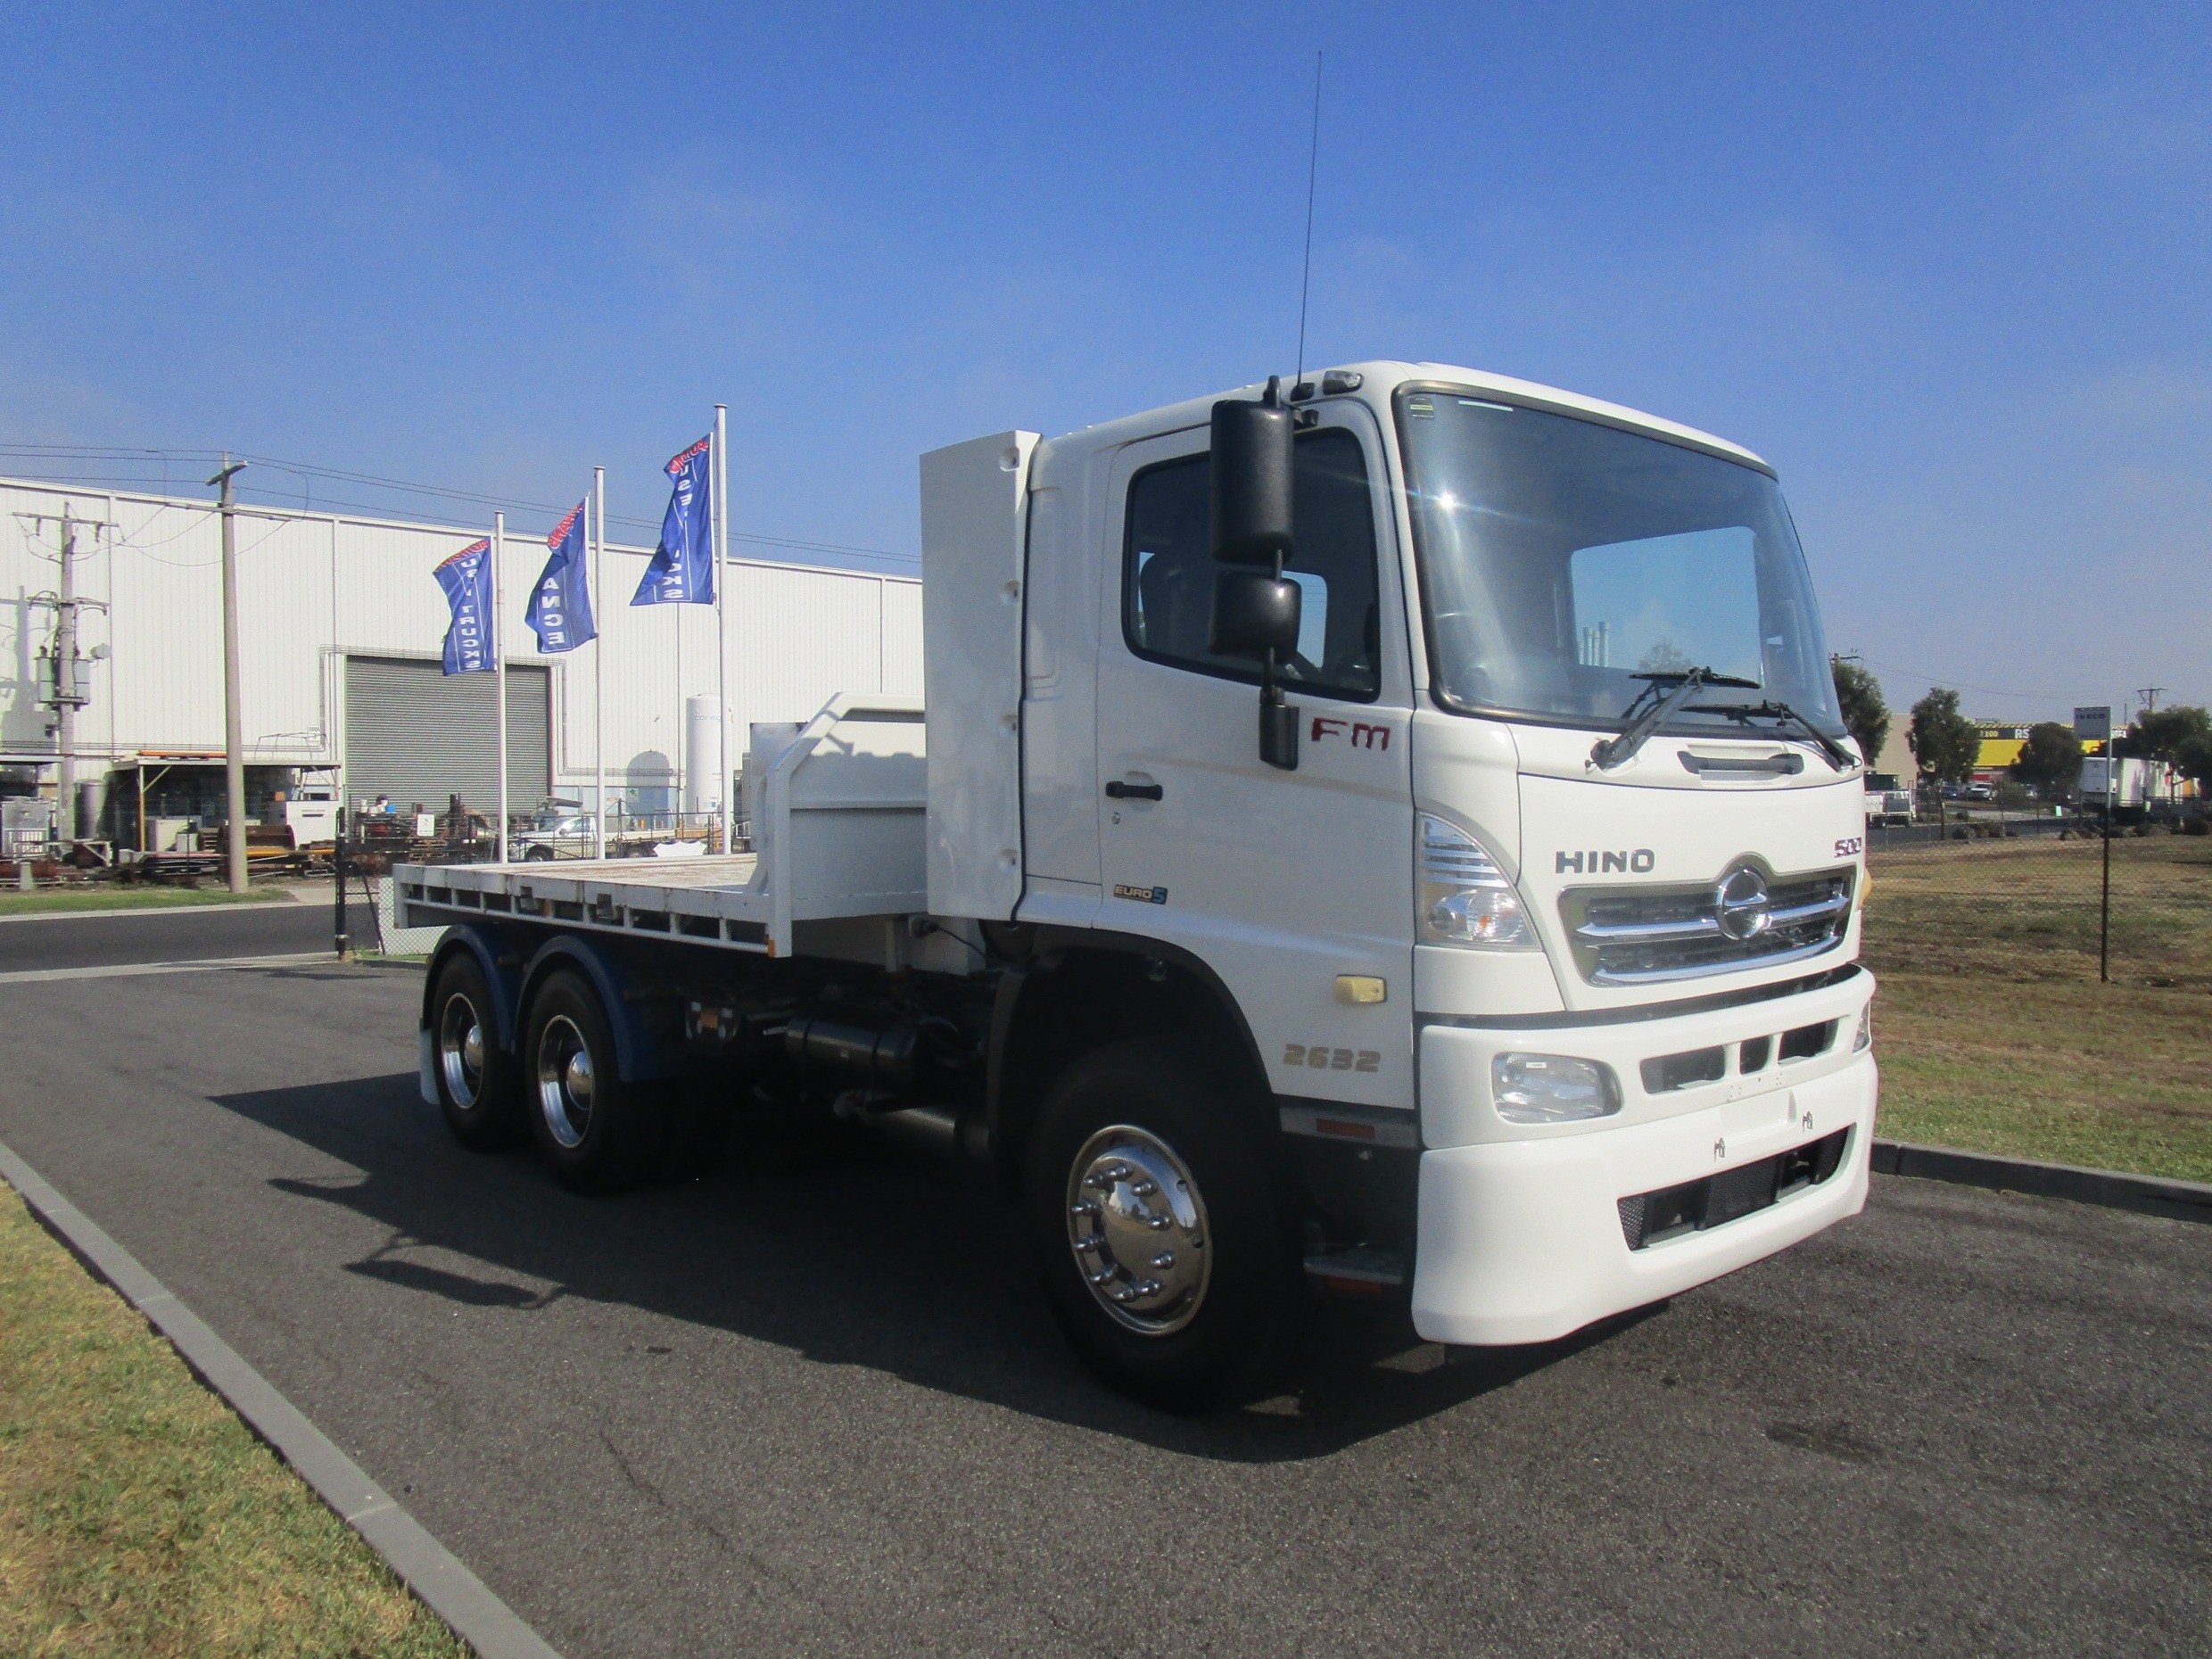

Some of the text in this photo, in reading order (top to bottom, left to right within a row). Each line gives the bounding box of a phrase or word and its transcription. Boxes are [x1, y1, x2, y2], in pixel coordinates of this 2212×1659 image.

[1311, 717, 1391, 751] FM
[1556, 848, 1655, 874] HINO
[1834, 837, 1862, 858] 500
[1283, 1043, 1382, 1073] 2632
